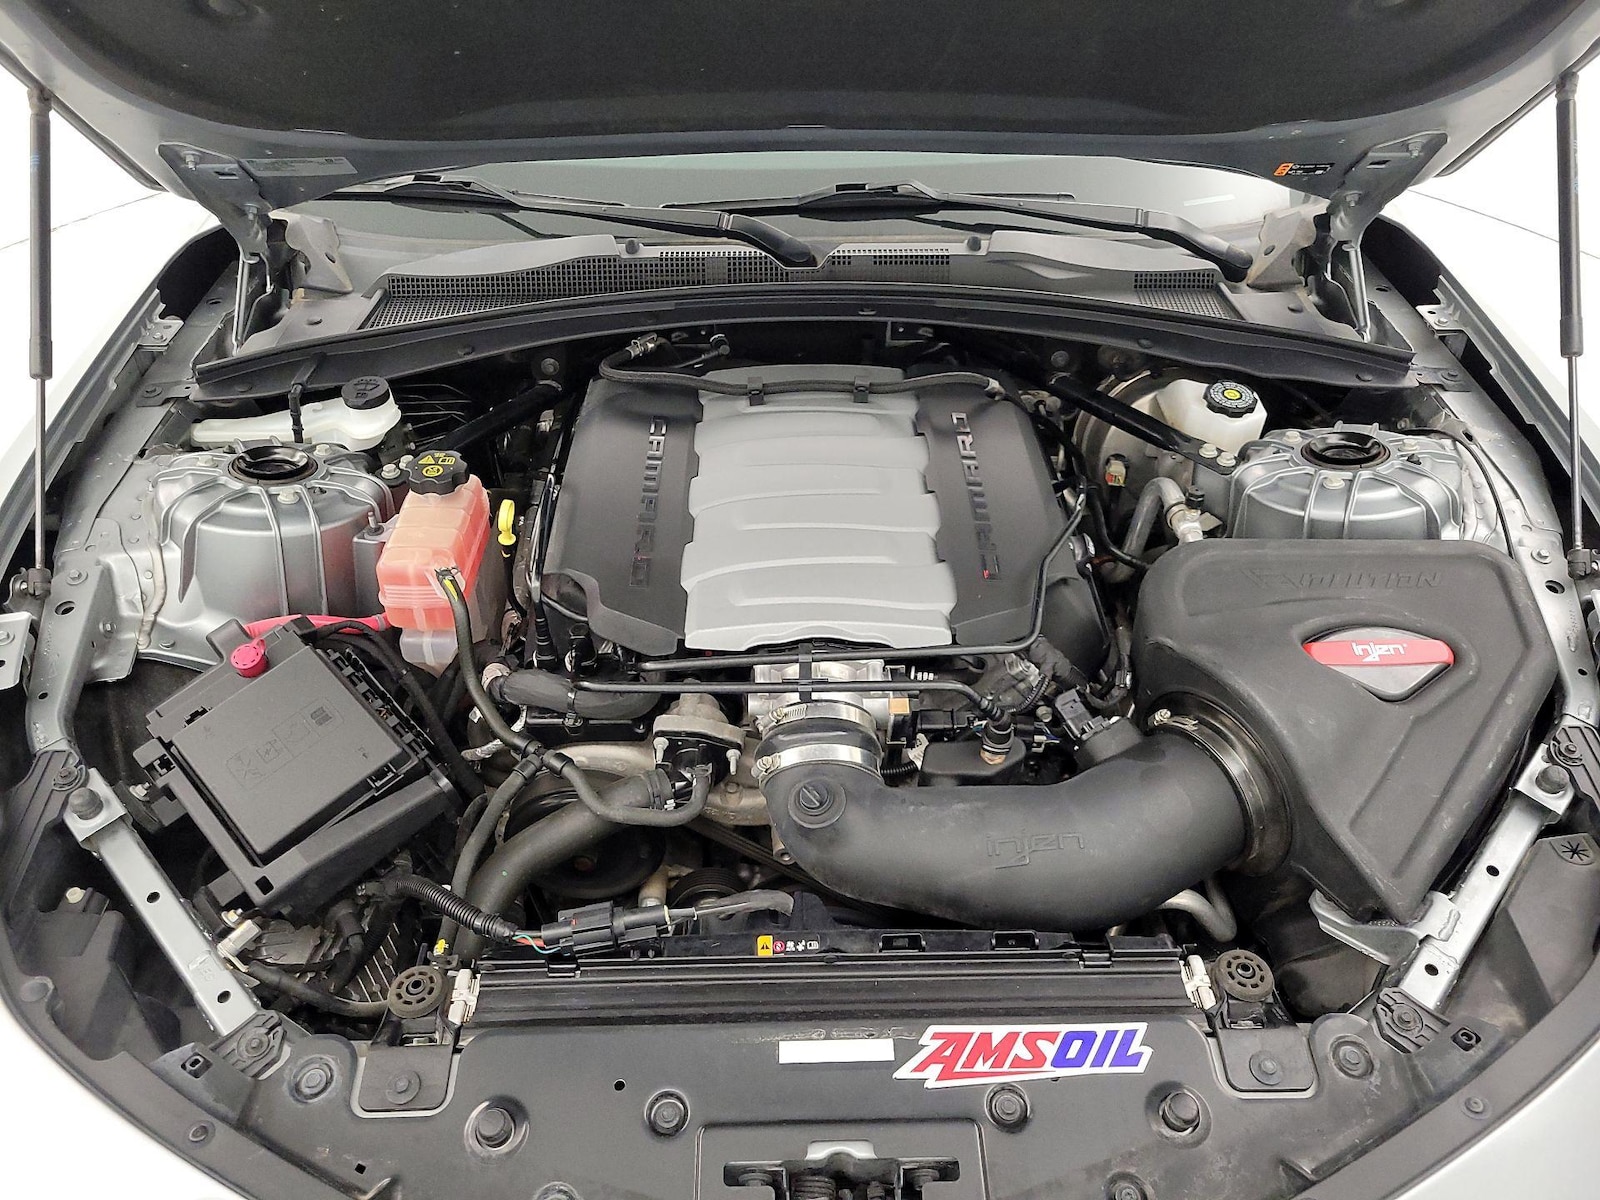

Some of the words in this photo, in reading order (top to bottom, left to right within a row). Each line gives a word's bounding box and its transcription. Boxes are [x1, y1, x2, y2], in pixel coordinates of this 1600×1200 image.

[951, 411, 1001, 582] CAMARO
[984, 828, 1086, 871] injen
[910, 1028, 1141, 1082] AMSOIL
